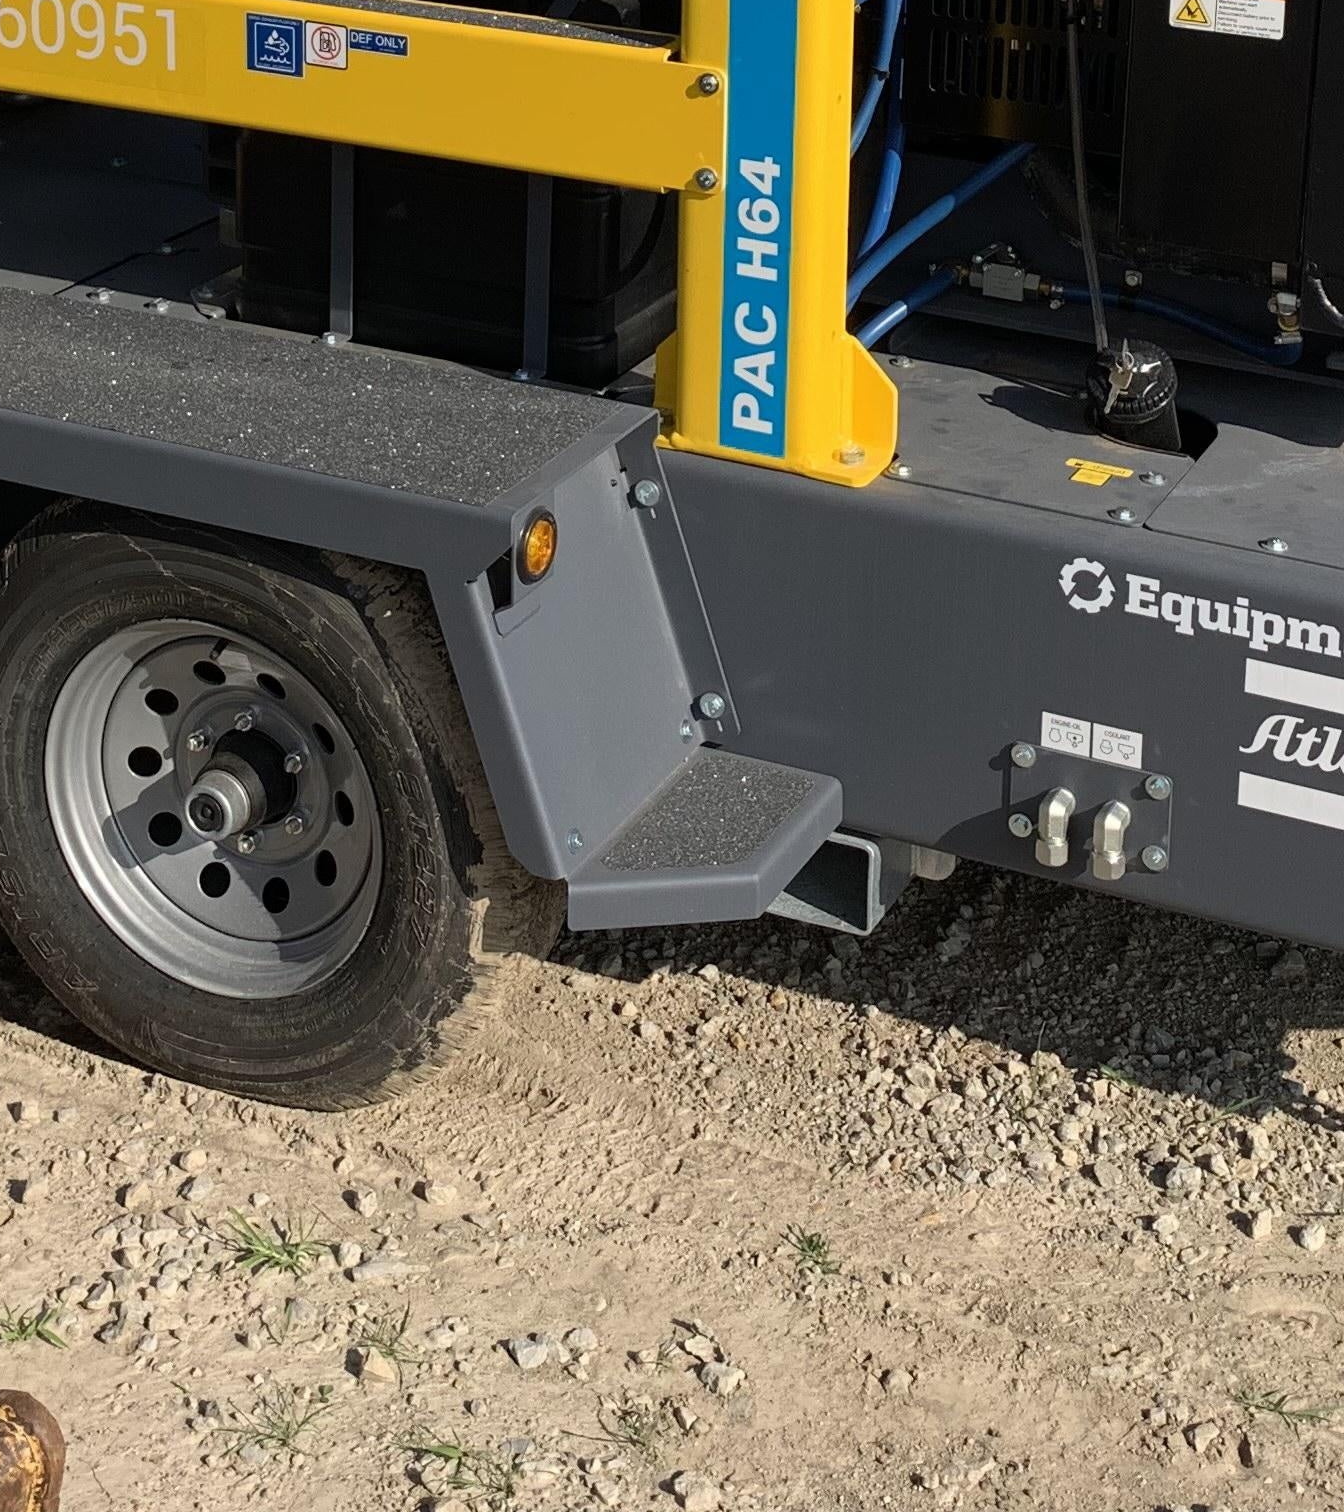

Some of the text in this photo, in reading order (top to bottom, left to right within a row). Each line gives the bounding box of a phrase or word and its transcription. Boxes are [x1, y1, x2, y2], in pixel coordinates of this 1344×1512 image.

[350, 31, 373, 44] DEF
[376, 35, 407, 49] ONLY
[732, 156, 781, 435] PAC H64
